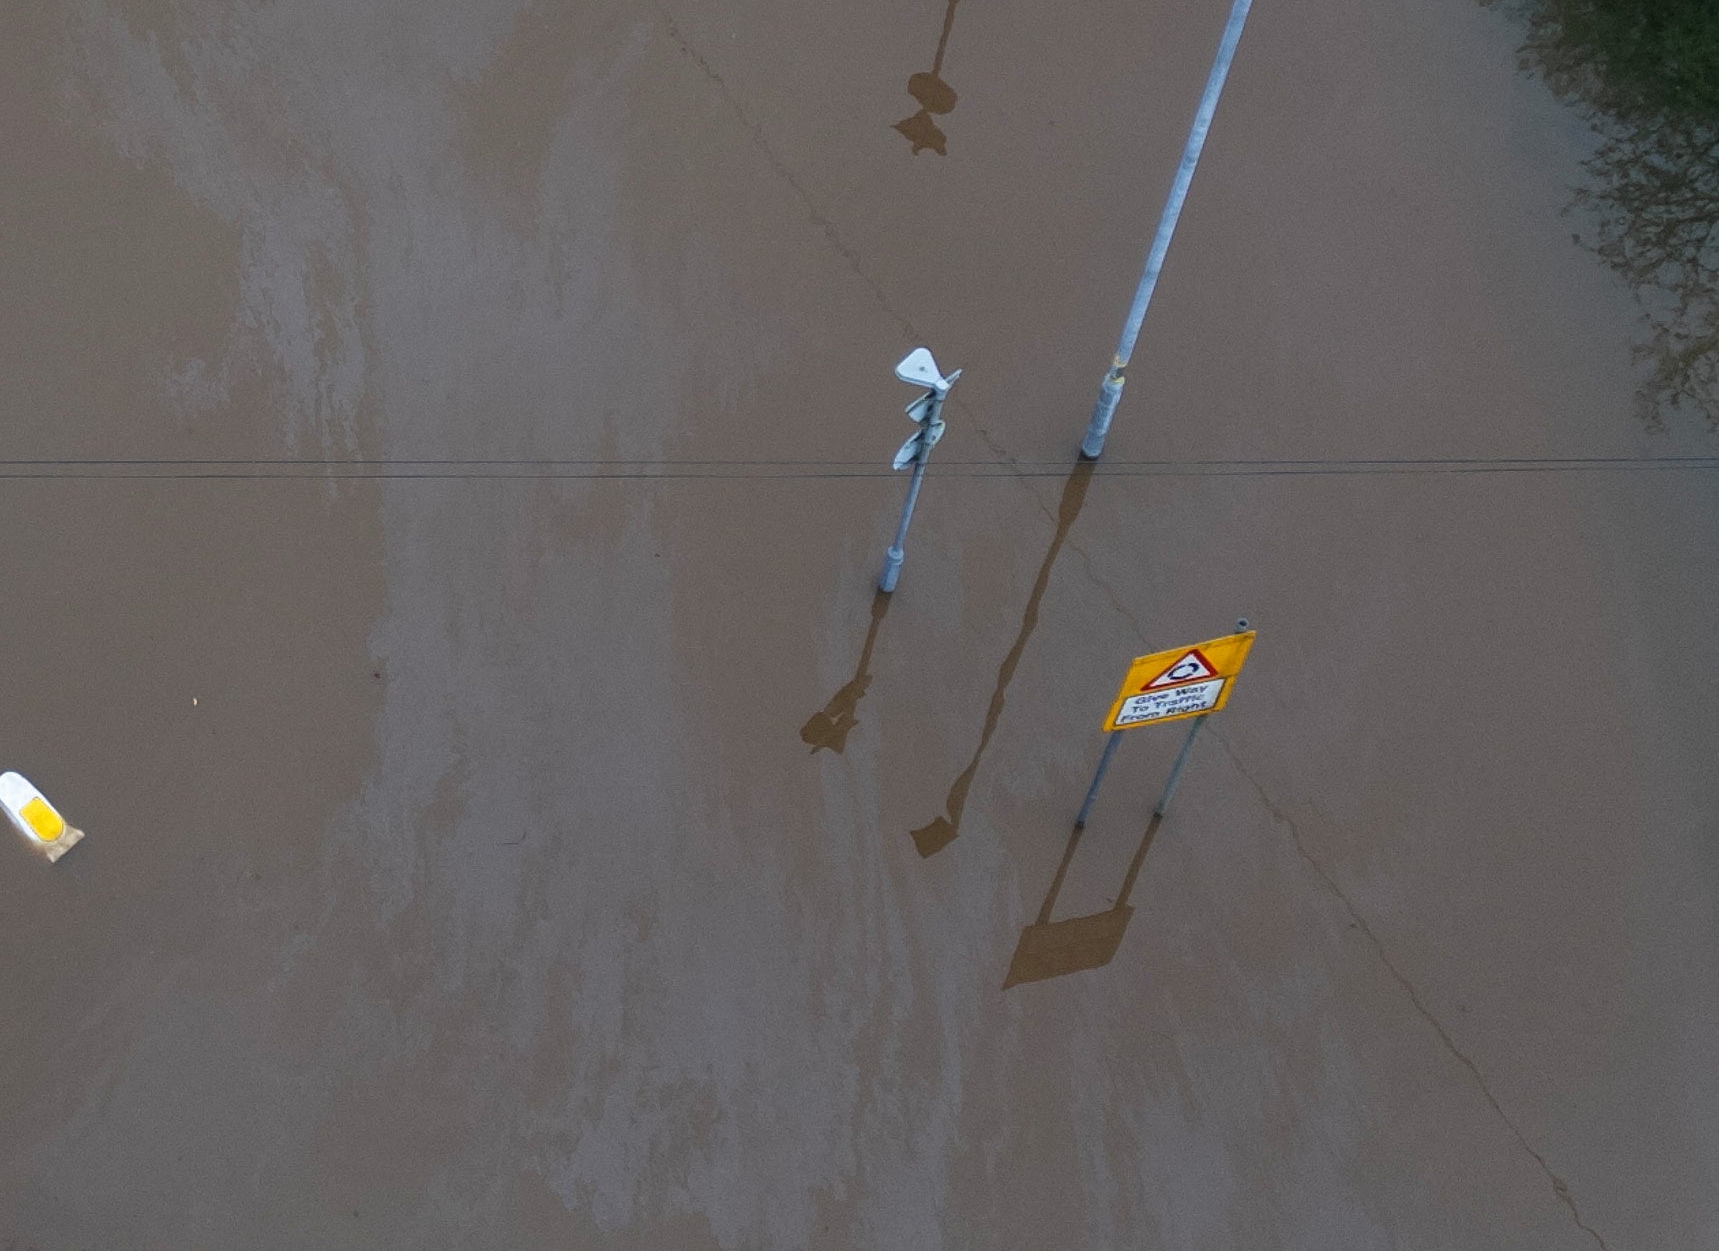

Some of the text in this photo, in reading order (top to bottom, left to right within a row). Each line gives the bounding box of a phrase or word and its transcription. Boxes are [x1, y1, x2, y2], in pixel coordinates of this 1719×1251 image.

[1135, 685, 1209, 705] Give Way
[1155, 694, 1206, 709] Traffic
[1120, 701, 1206, 722] From Right
